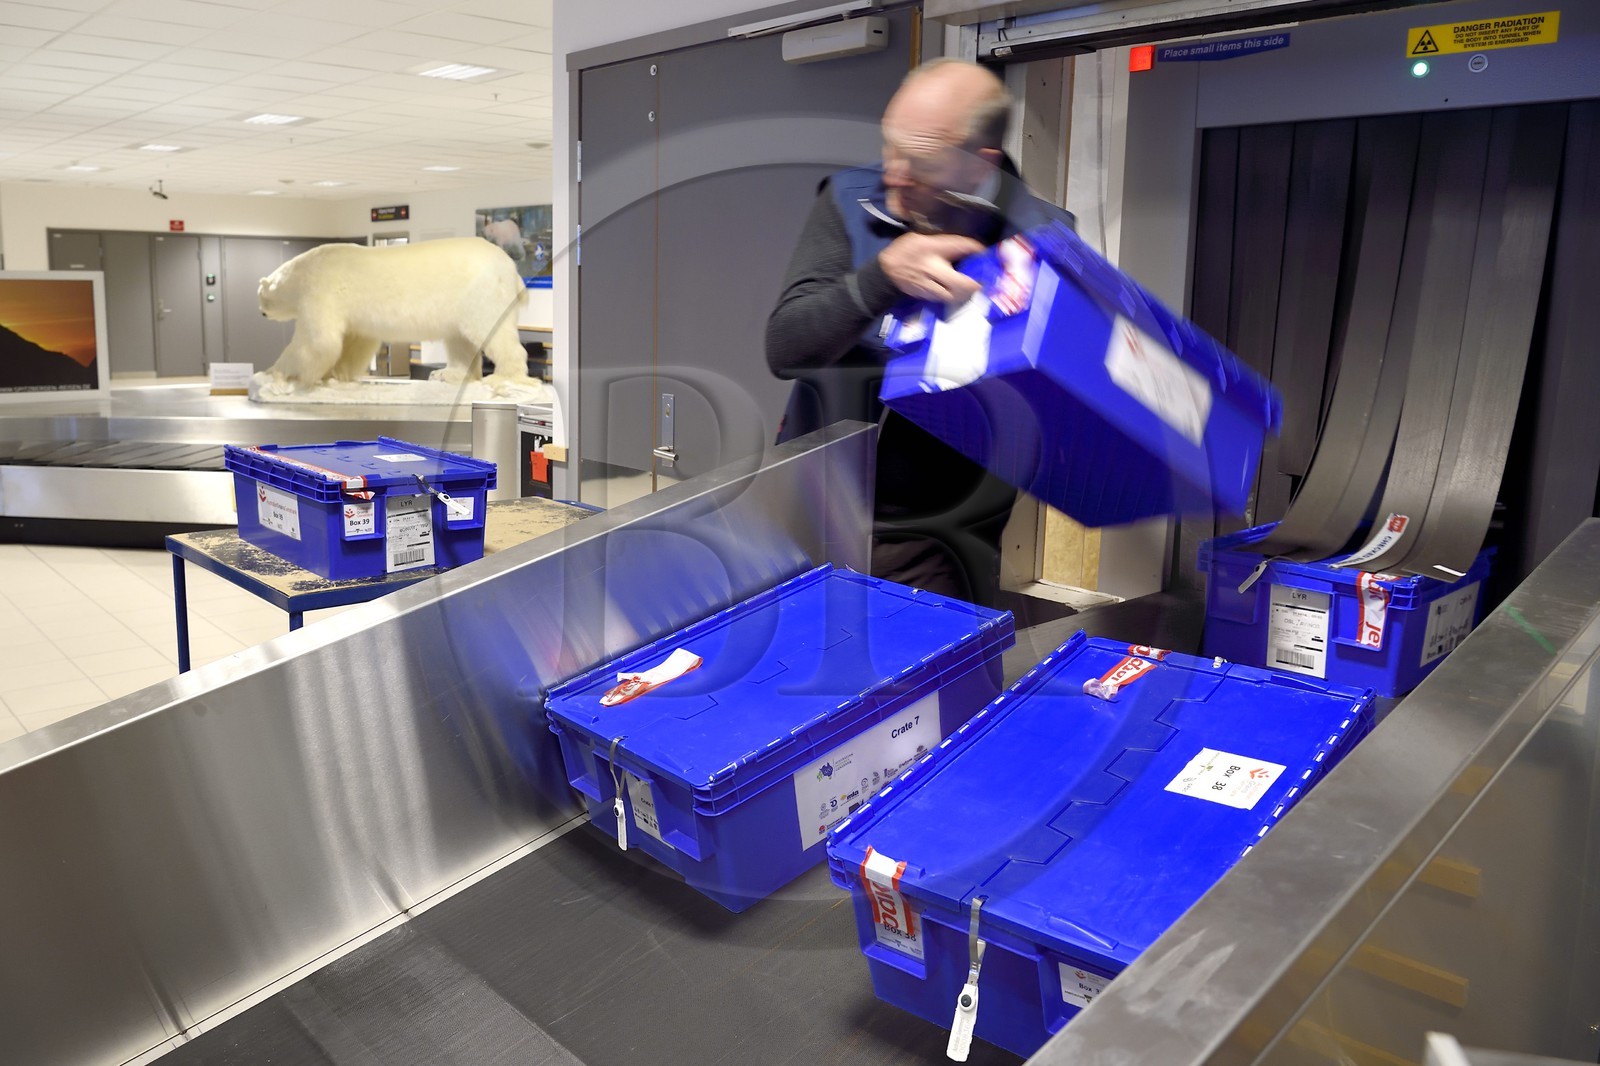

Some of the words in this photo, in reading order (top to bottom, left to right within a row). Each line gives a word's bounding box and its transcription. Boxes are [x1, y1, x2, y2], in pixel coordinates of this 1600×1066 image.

[1453, 22, 1491, 33] DANGER
[1493, 16, 1545, 29] RADIATION
[1495, 37, 1529, 45] ENERGISED
[1164, 48, 1188, 59] Place
[1190, 44, 1214, 55] small
[1216, 42, 1241, 53] items
[1244, 38, 1261, 49] this
[1264, 36, 1284, 46] side
[1292, 592, 1307, 600] LYR
[891, 720, 913, 739] Crate
[914, 716, 920, 726] 7
[1223, 765, 1241, 778] Box
[1211, 781, 1227, 791] 38
[1079, 983, 1093, 992] Box
